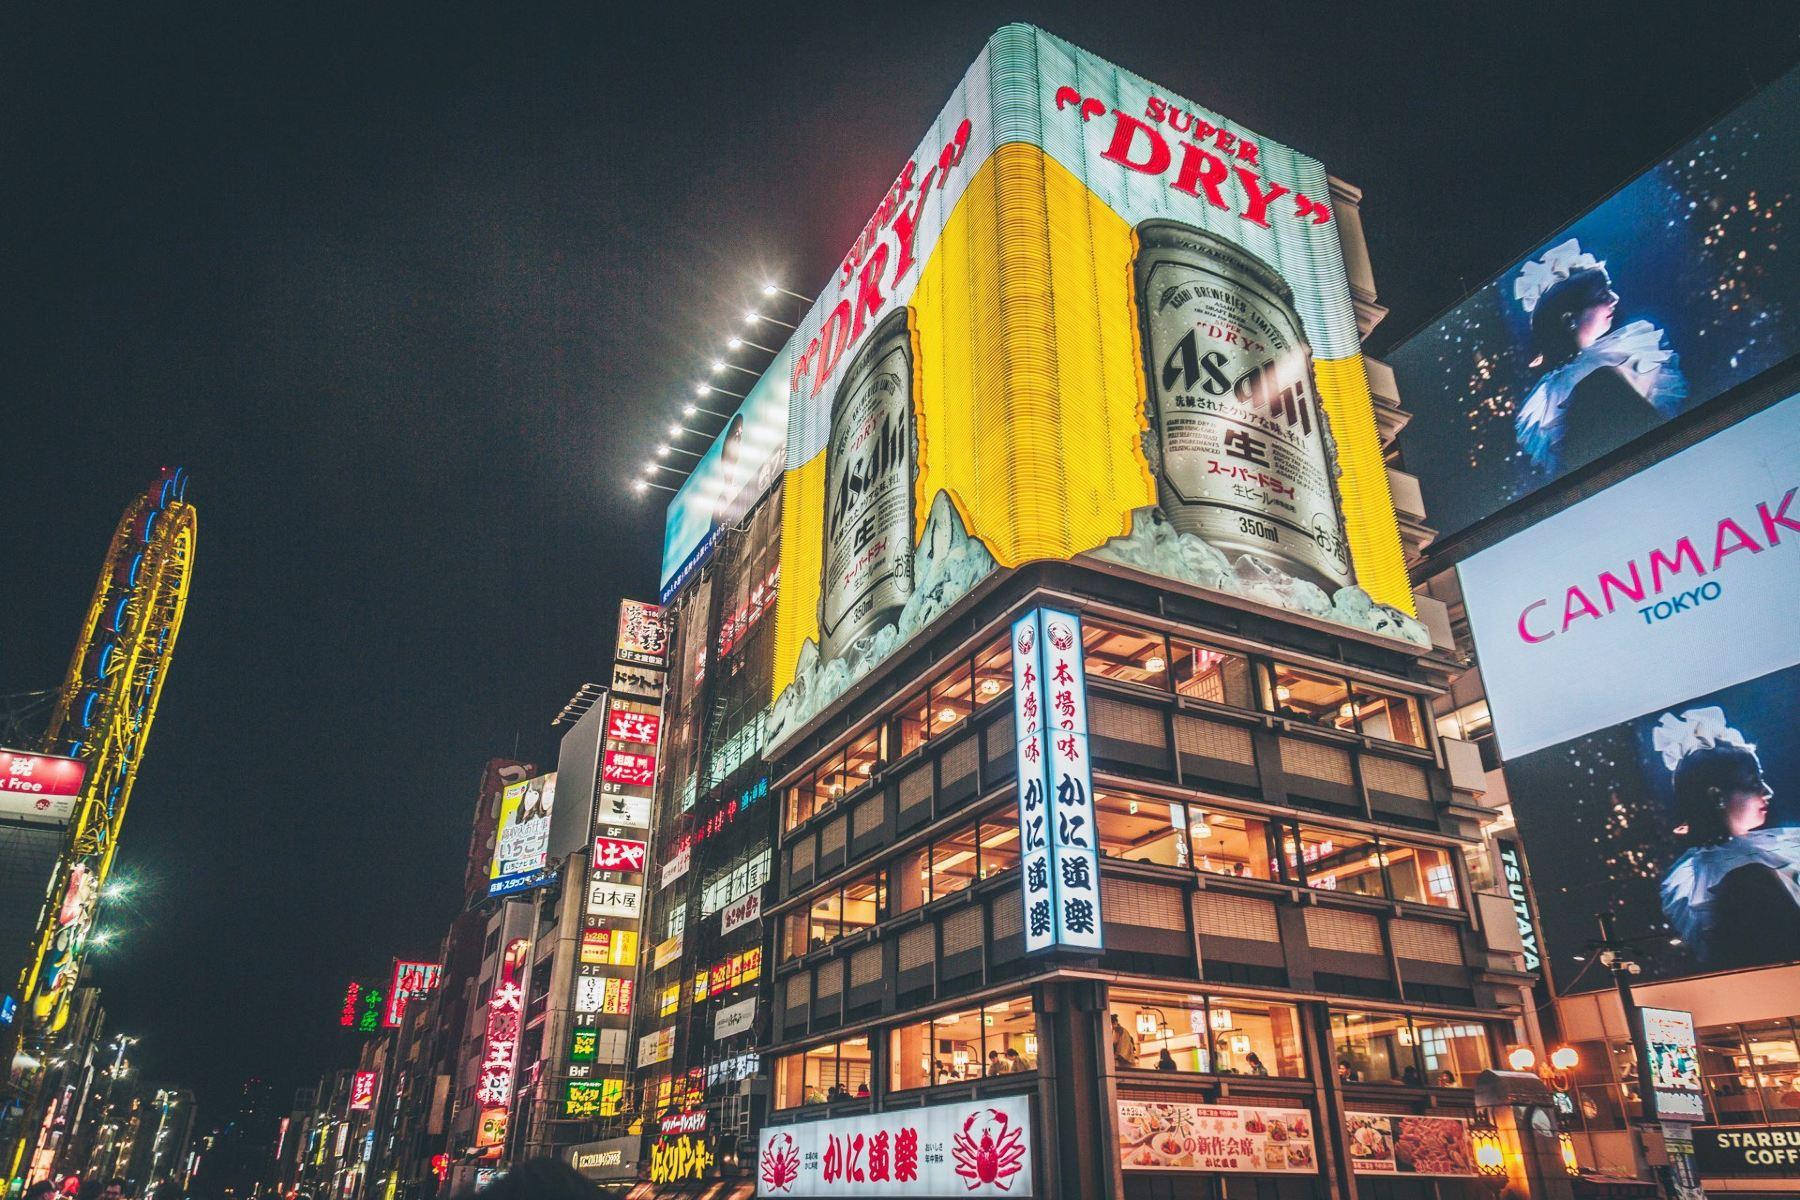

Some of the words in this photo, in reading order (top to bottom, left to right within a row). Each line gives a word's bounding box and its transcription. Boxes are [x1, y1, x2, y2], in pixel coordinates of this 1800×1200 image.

[1145, 96, 1260, 166] SUPER
[1194, 287, 1248, 314] BREWERIES
[1251, 311, 1283, 350] LIMITED
[1162, 327, 1312, 437] Asahi
[1224, 429, 1271, 468] 生
[830, 407, 905, 541] Asahi
[1207, 460, 1295, 500] スーパードライ
[1232, 484, 1274, 506] 生ビール
[854, 514, 876, 557] 生
[1238, 517, 1280, 543] 350ml
[1518, 486, 1800, 643] CANMAK
[1639, 581, 1722, 624] TOKYO
[1021, 663, 1040, 764] 本場の味
[1052, 658, 1079, 762] 本場の味
[8, 777, 42, 792] Free
[605, 764, 653, 783] ダイニング
[603, 783, 621, 793] 6F
[607, 828, 622, 837] 5F
[596, 842, 645, 869] はや
[592, 870, 612, 881] 4F
[591, 887, 636, 909] 白木屋
[1501, 850, 1540, 970] TSUTAYA
[588, 918, 606, 927] 3F
[582, 965, 600, 976] 2F
[576, 1014, 595, 1026] 1F
[569, 1066, 589, 1077] B1F
[1717, 1131, 1800, 1148] STARBU
[1745, 1149, 1800, 1165] COFF
